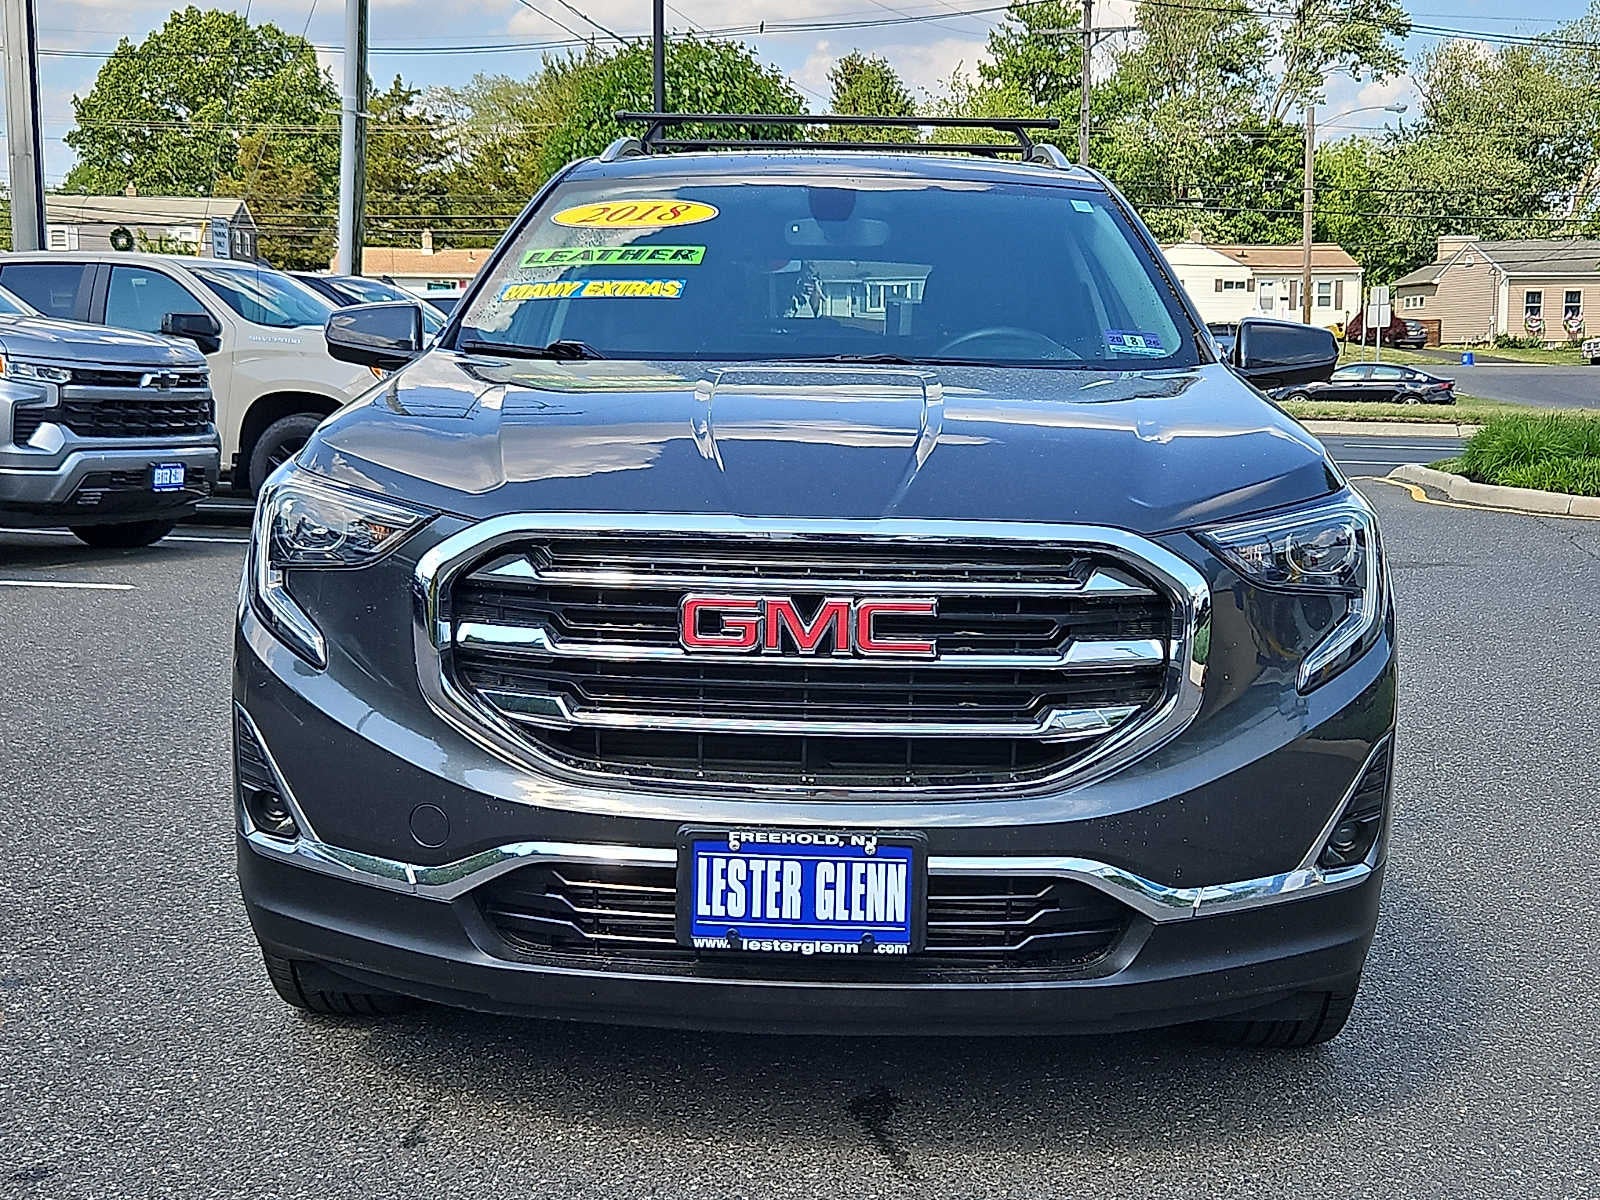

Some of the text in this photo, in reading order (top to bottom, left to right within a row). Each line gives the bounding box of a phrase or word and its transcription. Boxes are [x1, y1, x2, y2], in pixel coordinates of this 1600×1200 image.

[576, 205, 691, 224] 2018
[524, 248, 699, 264] LEATHER
[501, 281, 682, 299] MANY EXTRAS
[1129, 336, 1139, 346] 8
[679, 593, 938, 657] GMC
[728, 832, 877, 848] FREEHOLD, NJ
[697, 857, 907, 922] LESTER GLENN
[693, 938, 908, 955] www. lesterglenn .com
